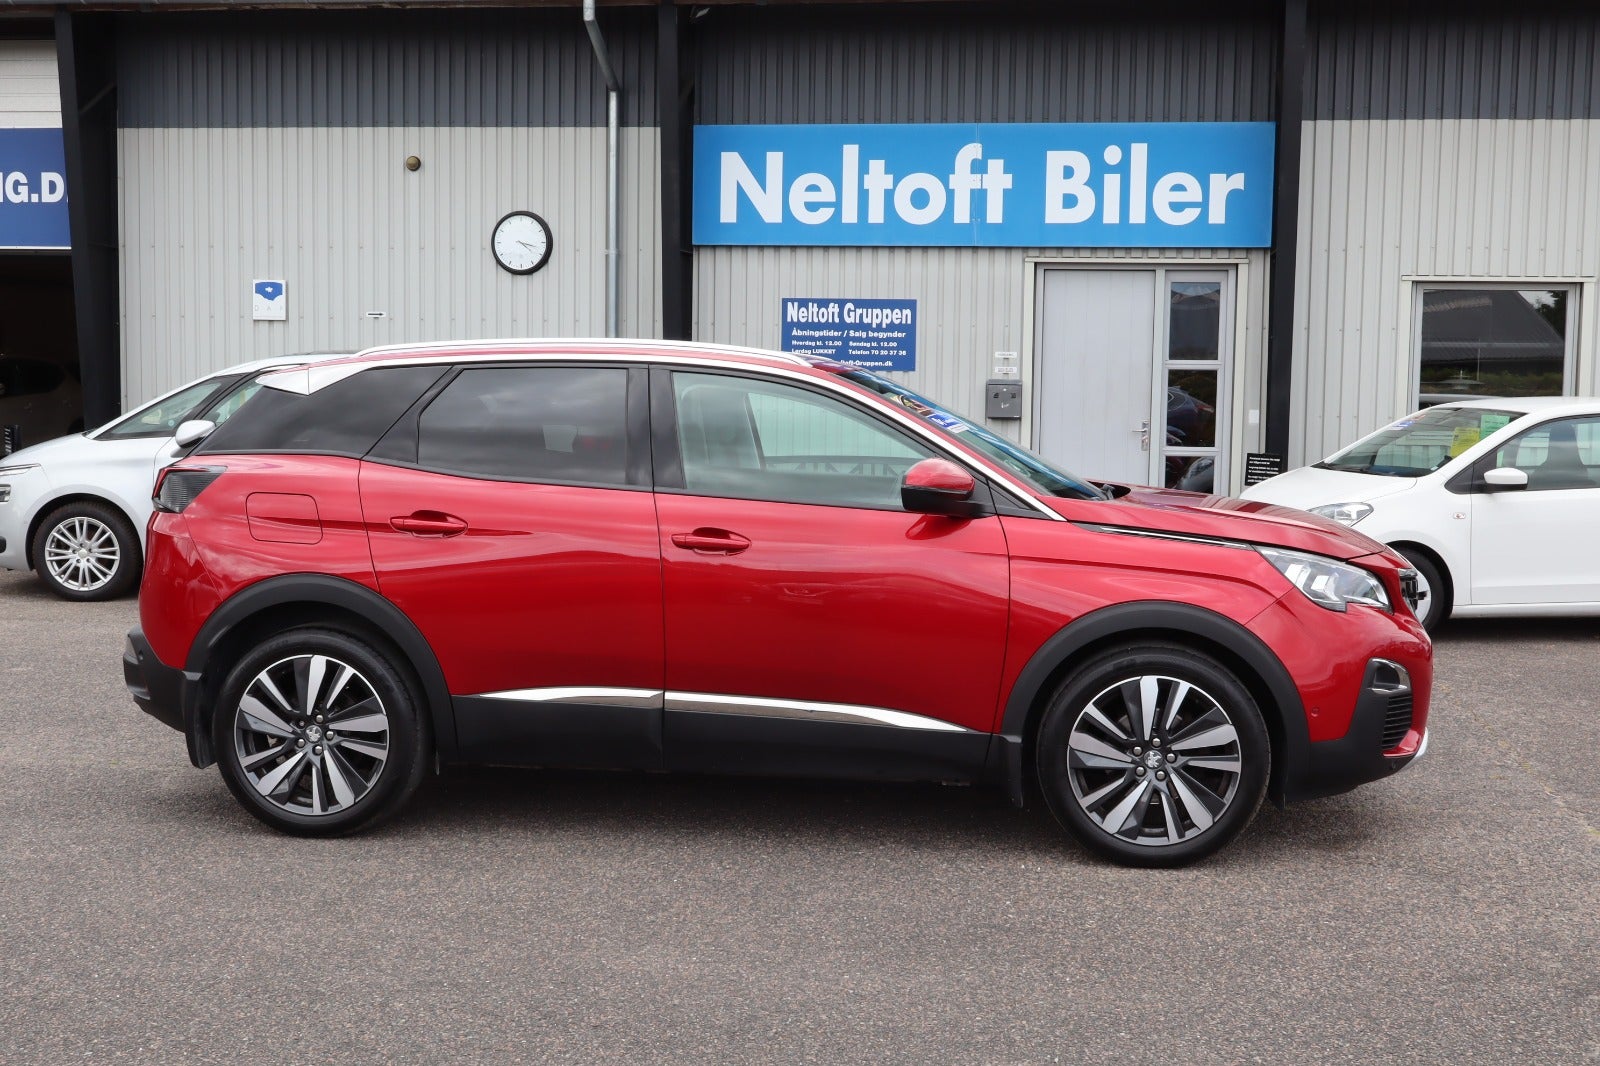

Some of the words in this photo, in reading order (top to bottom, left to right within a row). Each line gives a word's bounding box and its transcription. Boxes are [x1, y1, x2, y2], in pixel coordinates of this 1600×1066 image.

[0, 171, 68, 204] G.D
[719, 142, 1012, 225] Neltoft
[1044, 142, 1245, 226] Biler
[787, 302, 839, 323] Neltoft
[844, 302, 911, 328] Gruppen
[791, 327, 842, 337] Åbningstider
[843, 330, 847, 338] /
[849, 330, 867, 338] Salg
[868, 331, 906, 339] begynder
